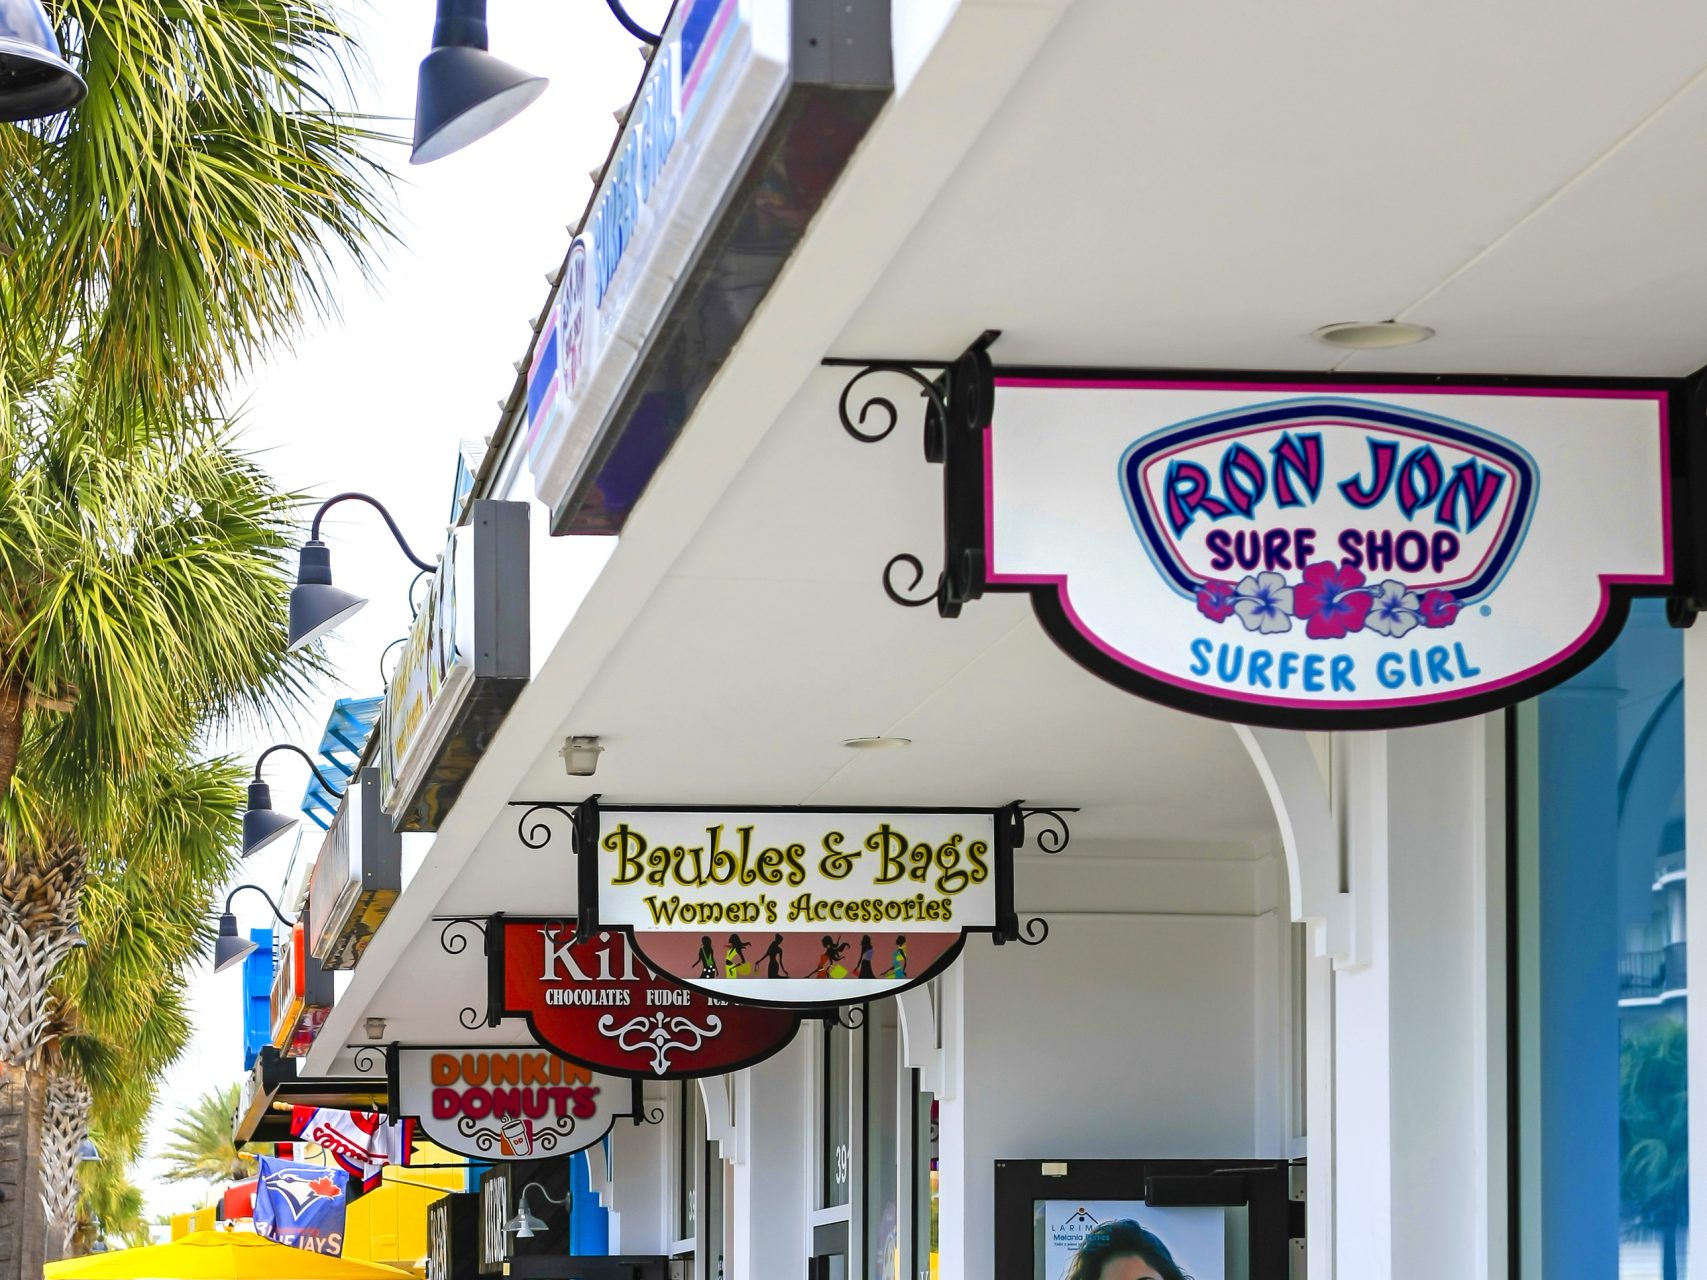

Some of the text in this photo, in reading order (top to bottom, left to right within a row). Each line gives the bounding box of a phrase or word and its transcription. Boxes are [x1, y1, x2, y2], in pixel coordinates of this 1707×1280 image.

[1162, 432, 1506, 540] RON JON
[1205, 528, 1461, 574] SURF SHOP
[1189, 637, 1481, 693] SURFER GIRL
[602, 823, 989, 896] Baubles & Bags
[643, 893, 954, 926] Women's Accessories
[537, 929, 658, 981] Kil
[545, 989, 631, 1006] CHOCOLATES
[646, 989, 691, 1006] FUDGE
[432, 1086, 597, 1120] DONUTS
[835, 1144, 851, 1185] 39
[1051, 1224, 1113, 1232] LARIMR
